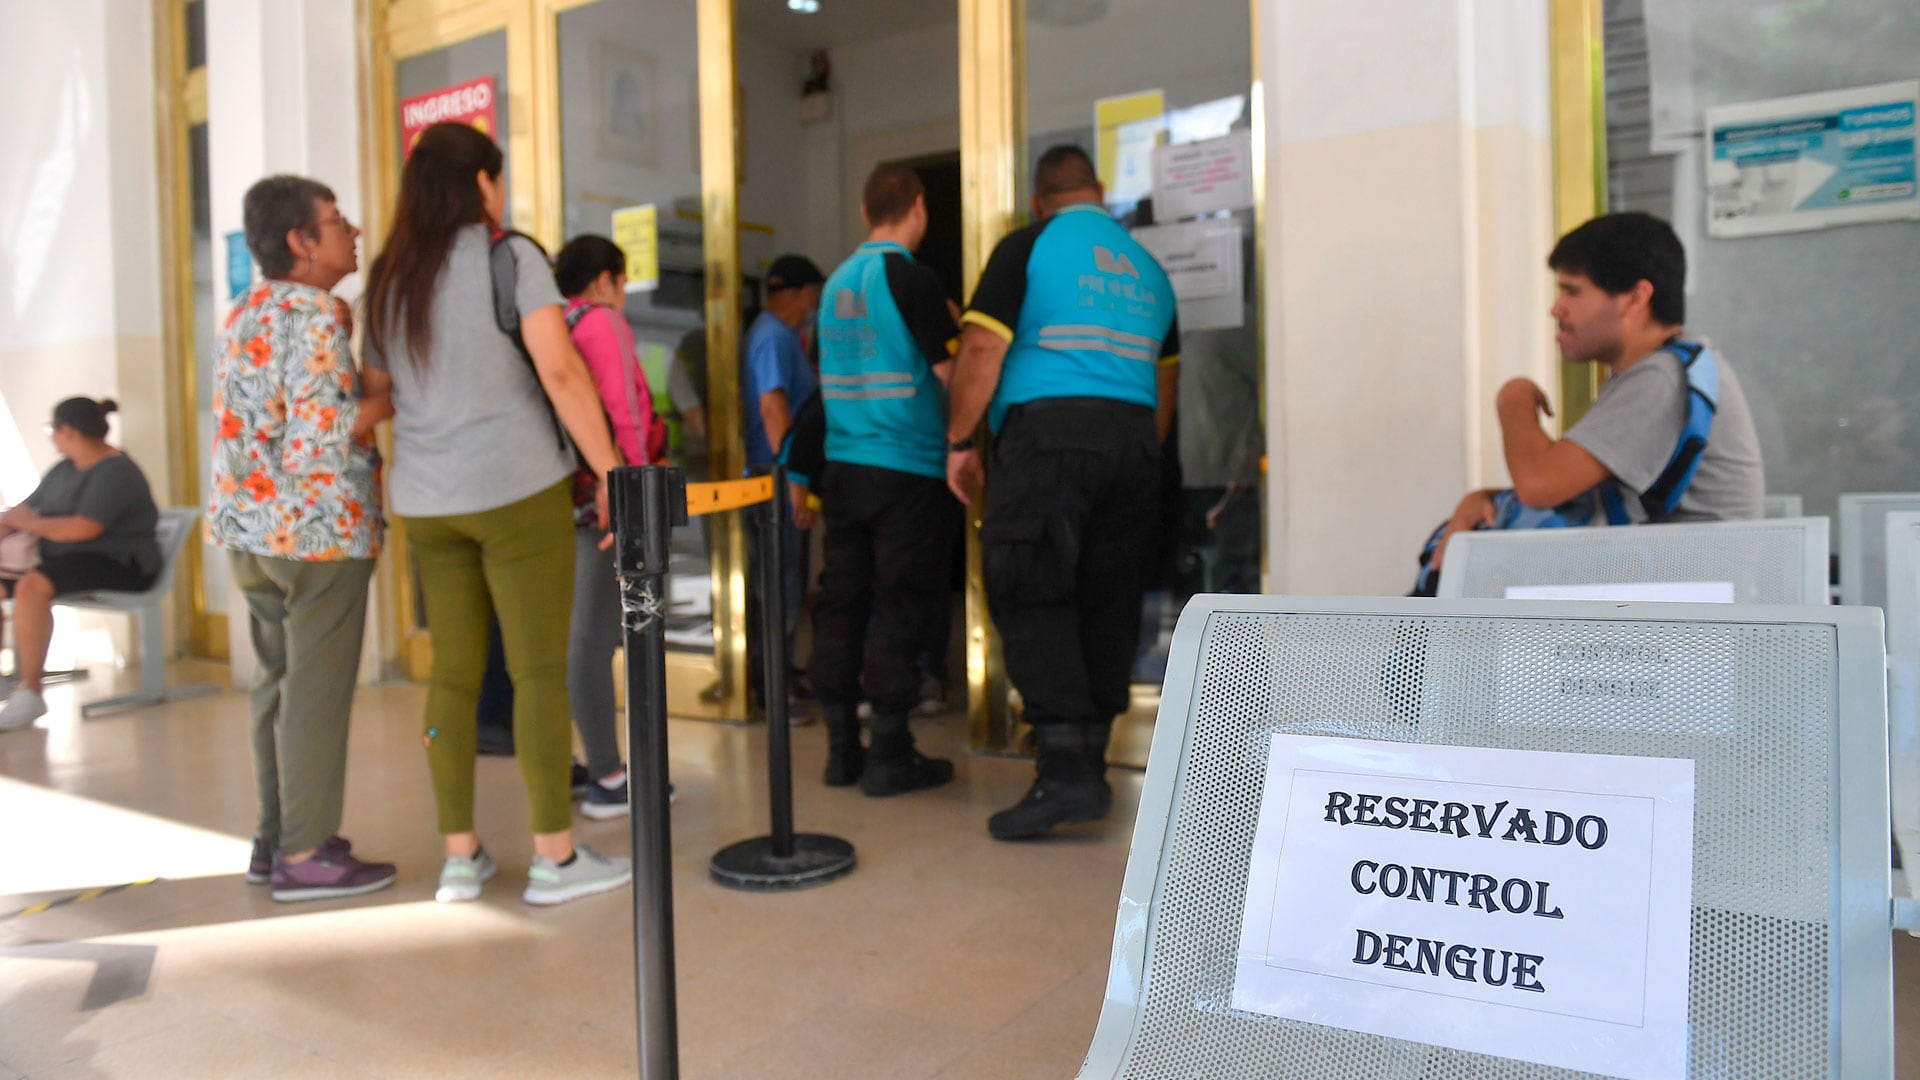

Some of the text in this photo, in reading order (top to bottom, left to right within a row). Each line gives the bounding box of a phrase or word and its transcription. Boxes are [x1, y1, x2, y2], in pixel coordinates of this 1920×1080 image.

[403, 83, 492, 128] INGRESO
[1324, 791, 1609, 850] RESERVADO
[1350, 860, 1564, 919] CONTROL
[1352, 929, 1546, 993] DENGUE
